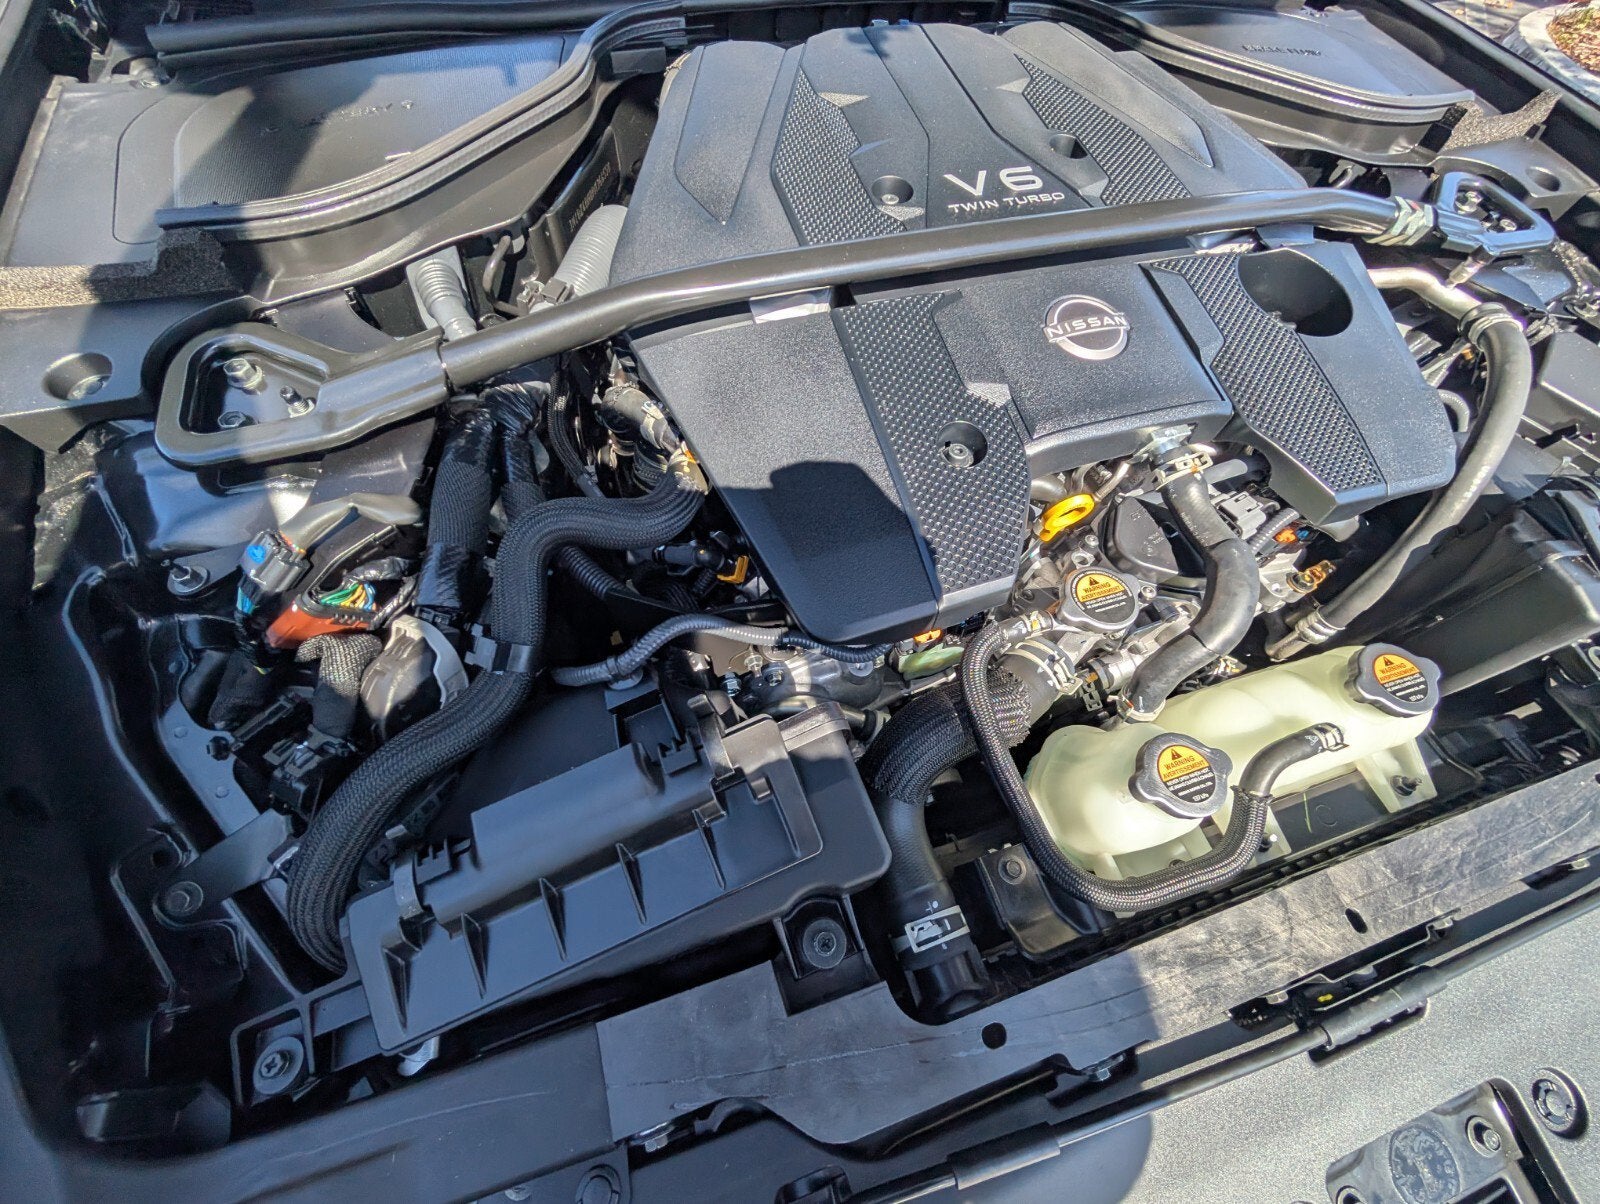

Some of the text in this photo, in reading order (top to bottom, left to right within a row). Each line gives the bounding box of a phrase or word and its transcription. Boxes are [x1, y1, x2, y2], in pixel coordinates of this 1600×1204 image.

[948, 192, 1065, 213] TWIN TURBO
[1046, 316, 1127, 338] NISSAN
[1083, 582, 1111, 593] WARNING
[1379, 663, 1407, 675] WARNING
[1163, 760, 1206, 779] AVERTISSEMENT
[1164, 756, 1195, 770] WARNING
